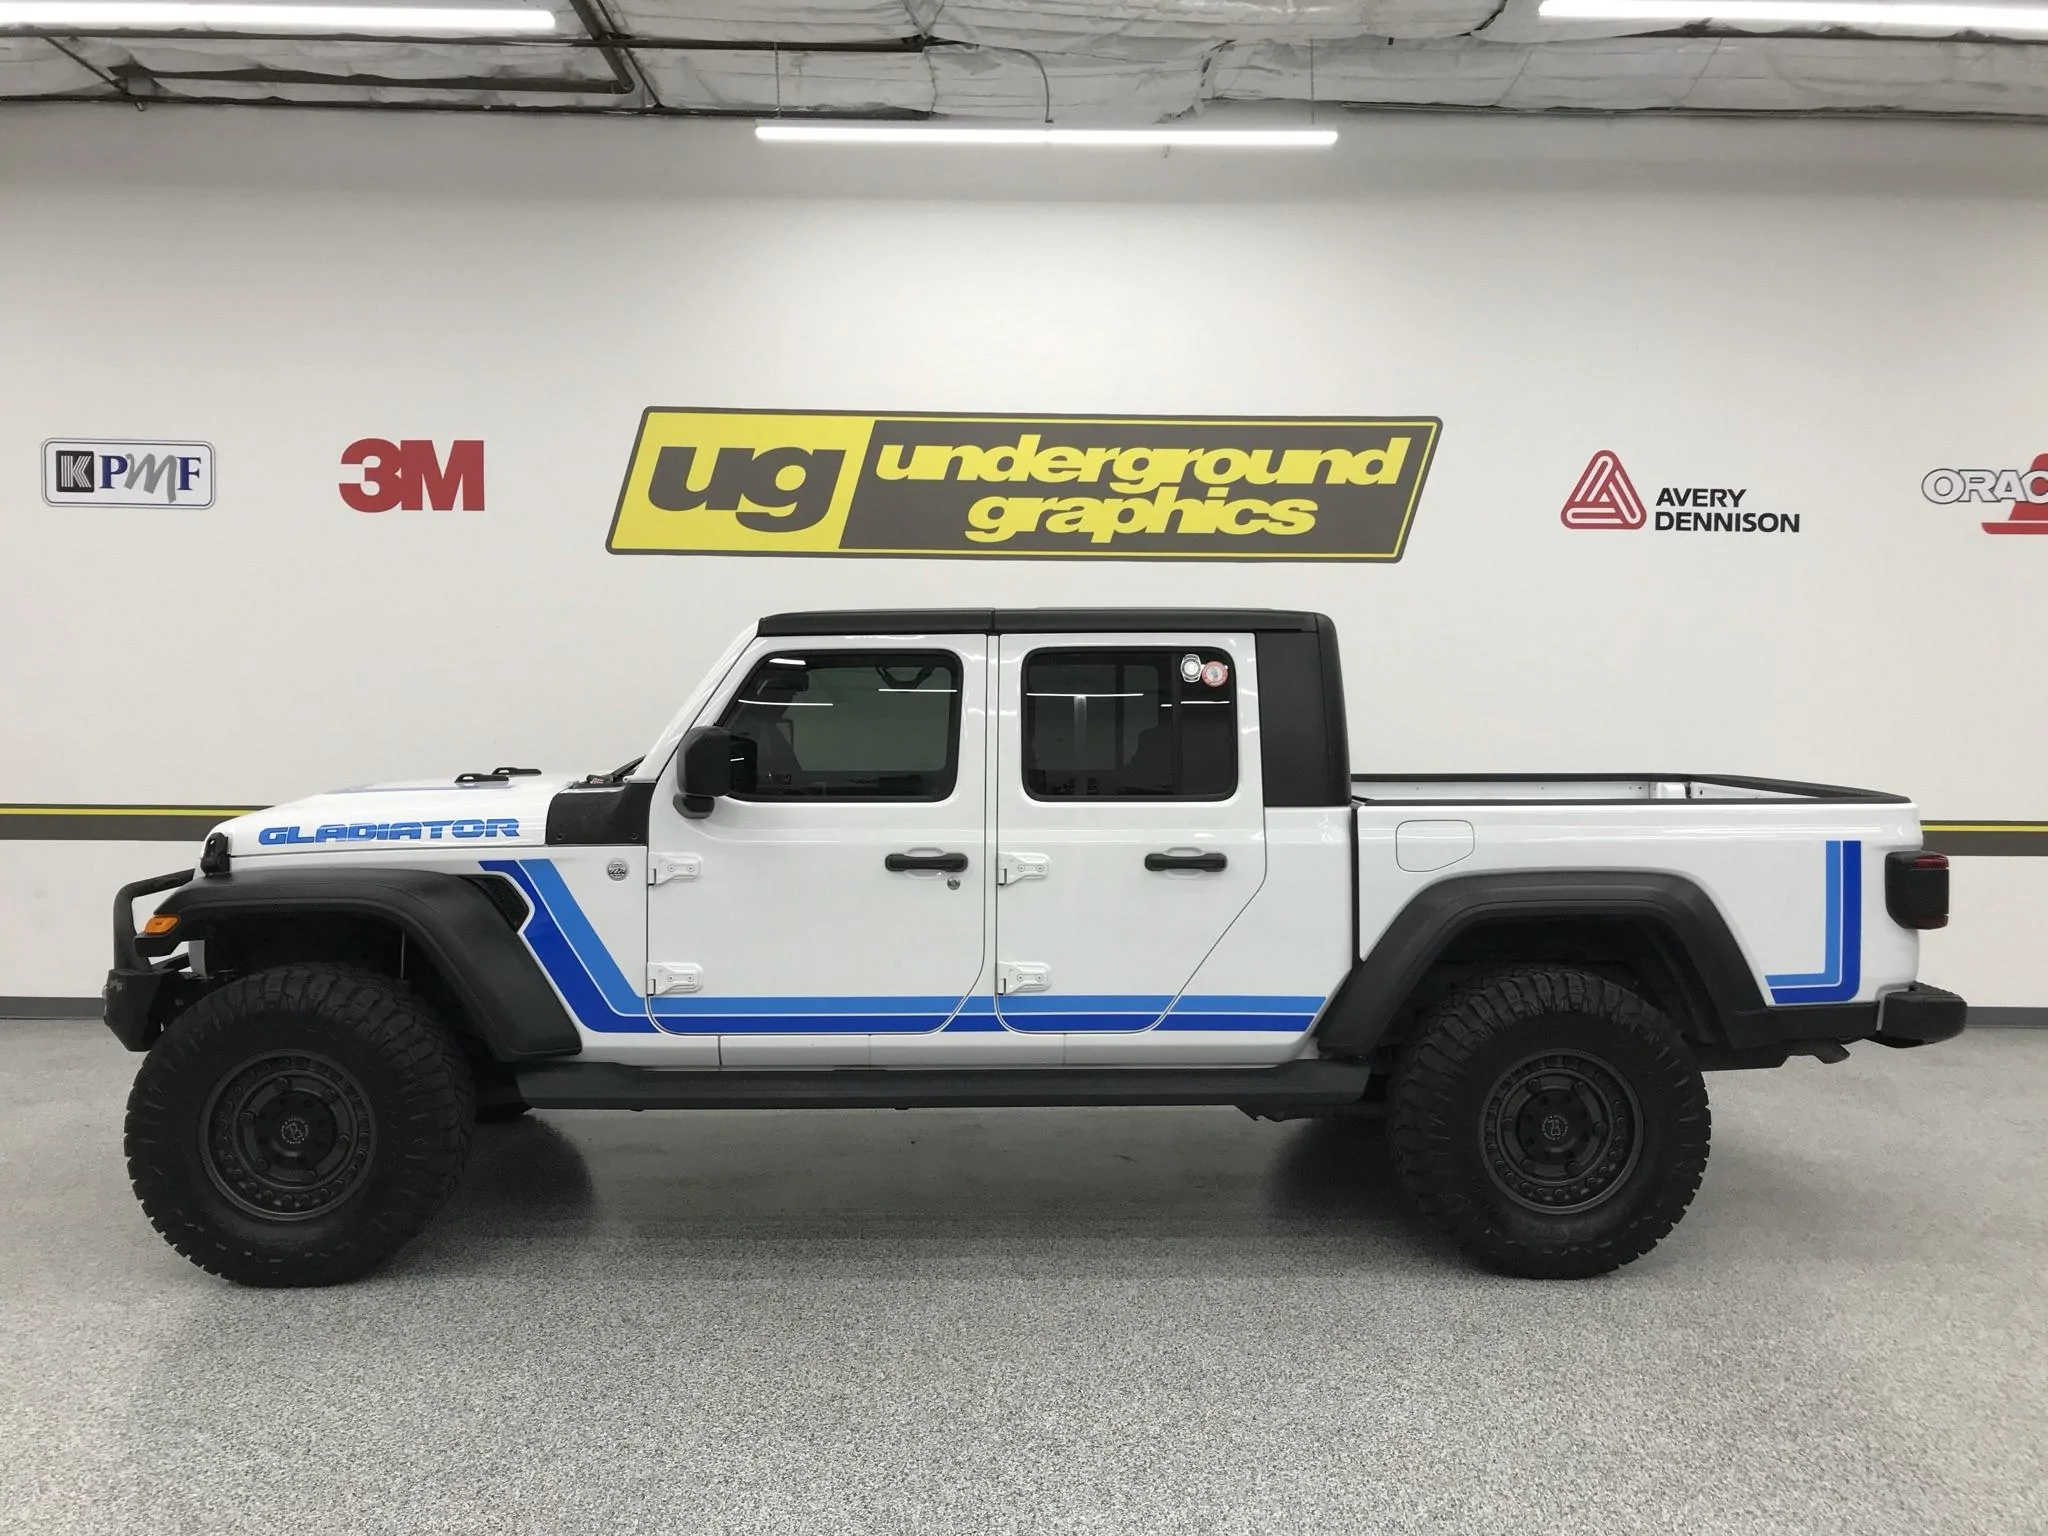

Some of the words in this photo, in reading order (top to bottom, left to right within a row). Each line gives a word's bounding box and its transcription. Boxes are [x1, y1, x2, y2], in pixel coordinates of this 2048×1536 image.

[339, 438, 485, 513] 3M
[648, 446, 846, 532] ug
[875, 434, 1411, 493] underground
[965, 485, 1317, 543] graphics
[1655, 512, 1800, 533] DENNISON
[1656, 488, 1747, 508] AVERY
[258, 818, 520, 846] GLADIATOR
